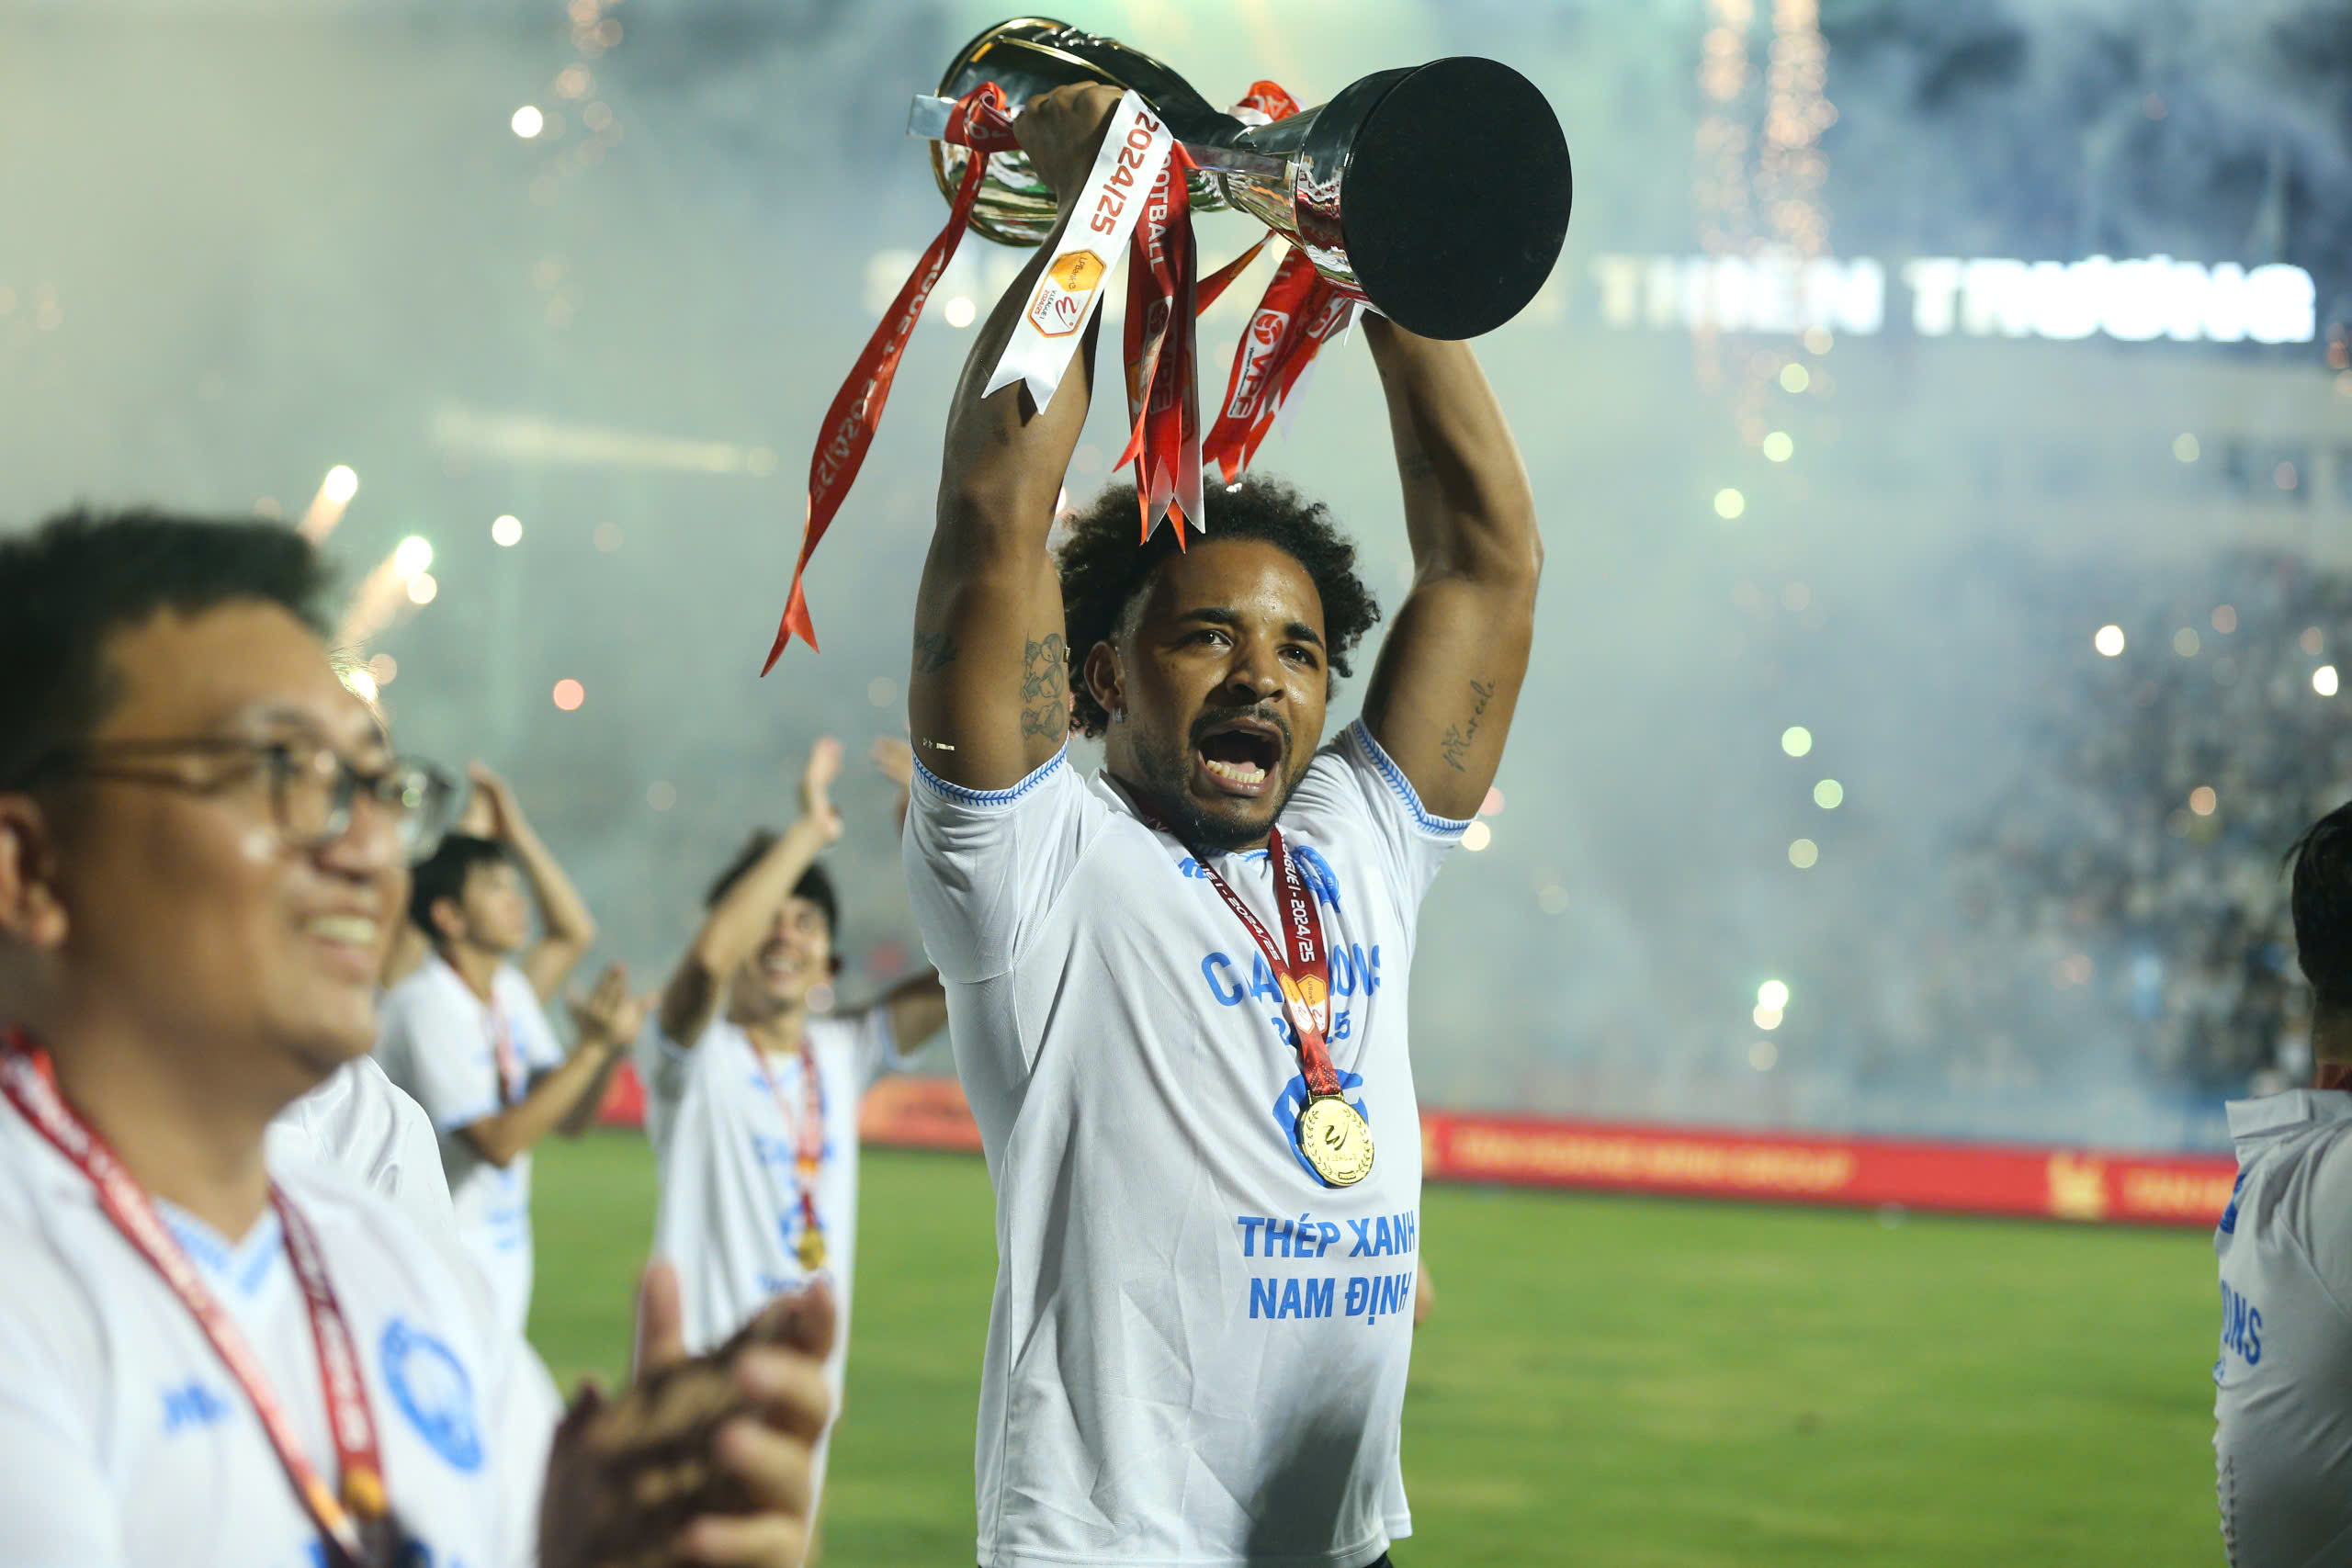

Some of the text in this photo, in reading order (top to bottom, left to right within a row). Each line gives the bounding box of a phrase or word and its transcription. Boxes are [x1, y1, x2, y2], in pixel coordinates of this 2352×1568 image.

[1091, 111, 1159, 235] 2024/25
[1148, 151, 1171, 274] OOTBALL
[1237, 353, 1275, 416] VPF
[1227, 897, 1282, 962] 2024/25
[1290, 898, 1316, 964] 2024/25
[1238, 1210, 1416, 1258] THÉP XANH
[1250, 1271, 1412, 1325] NAM ĐỊNH
